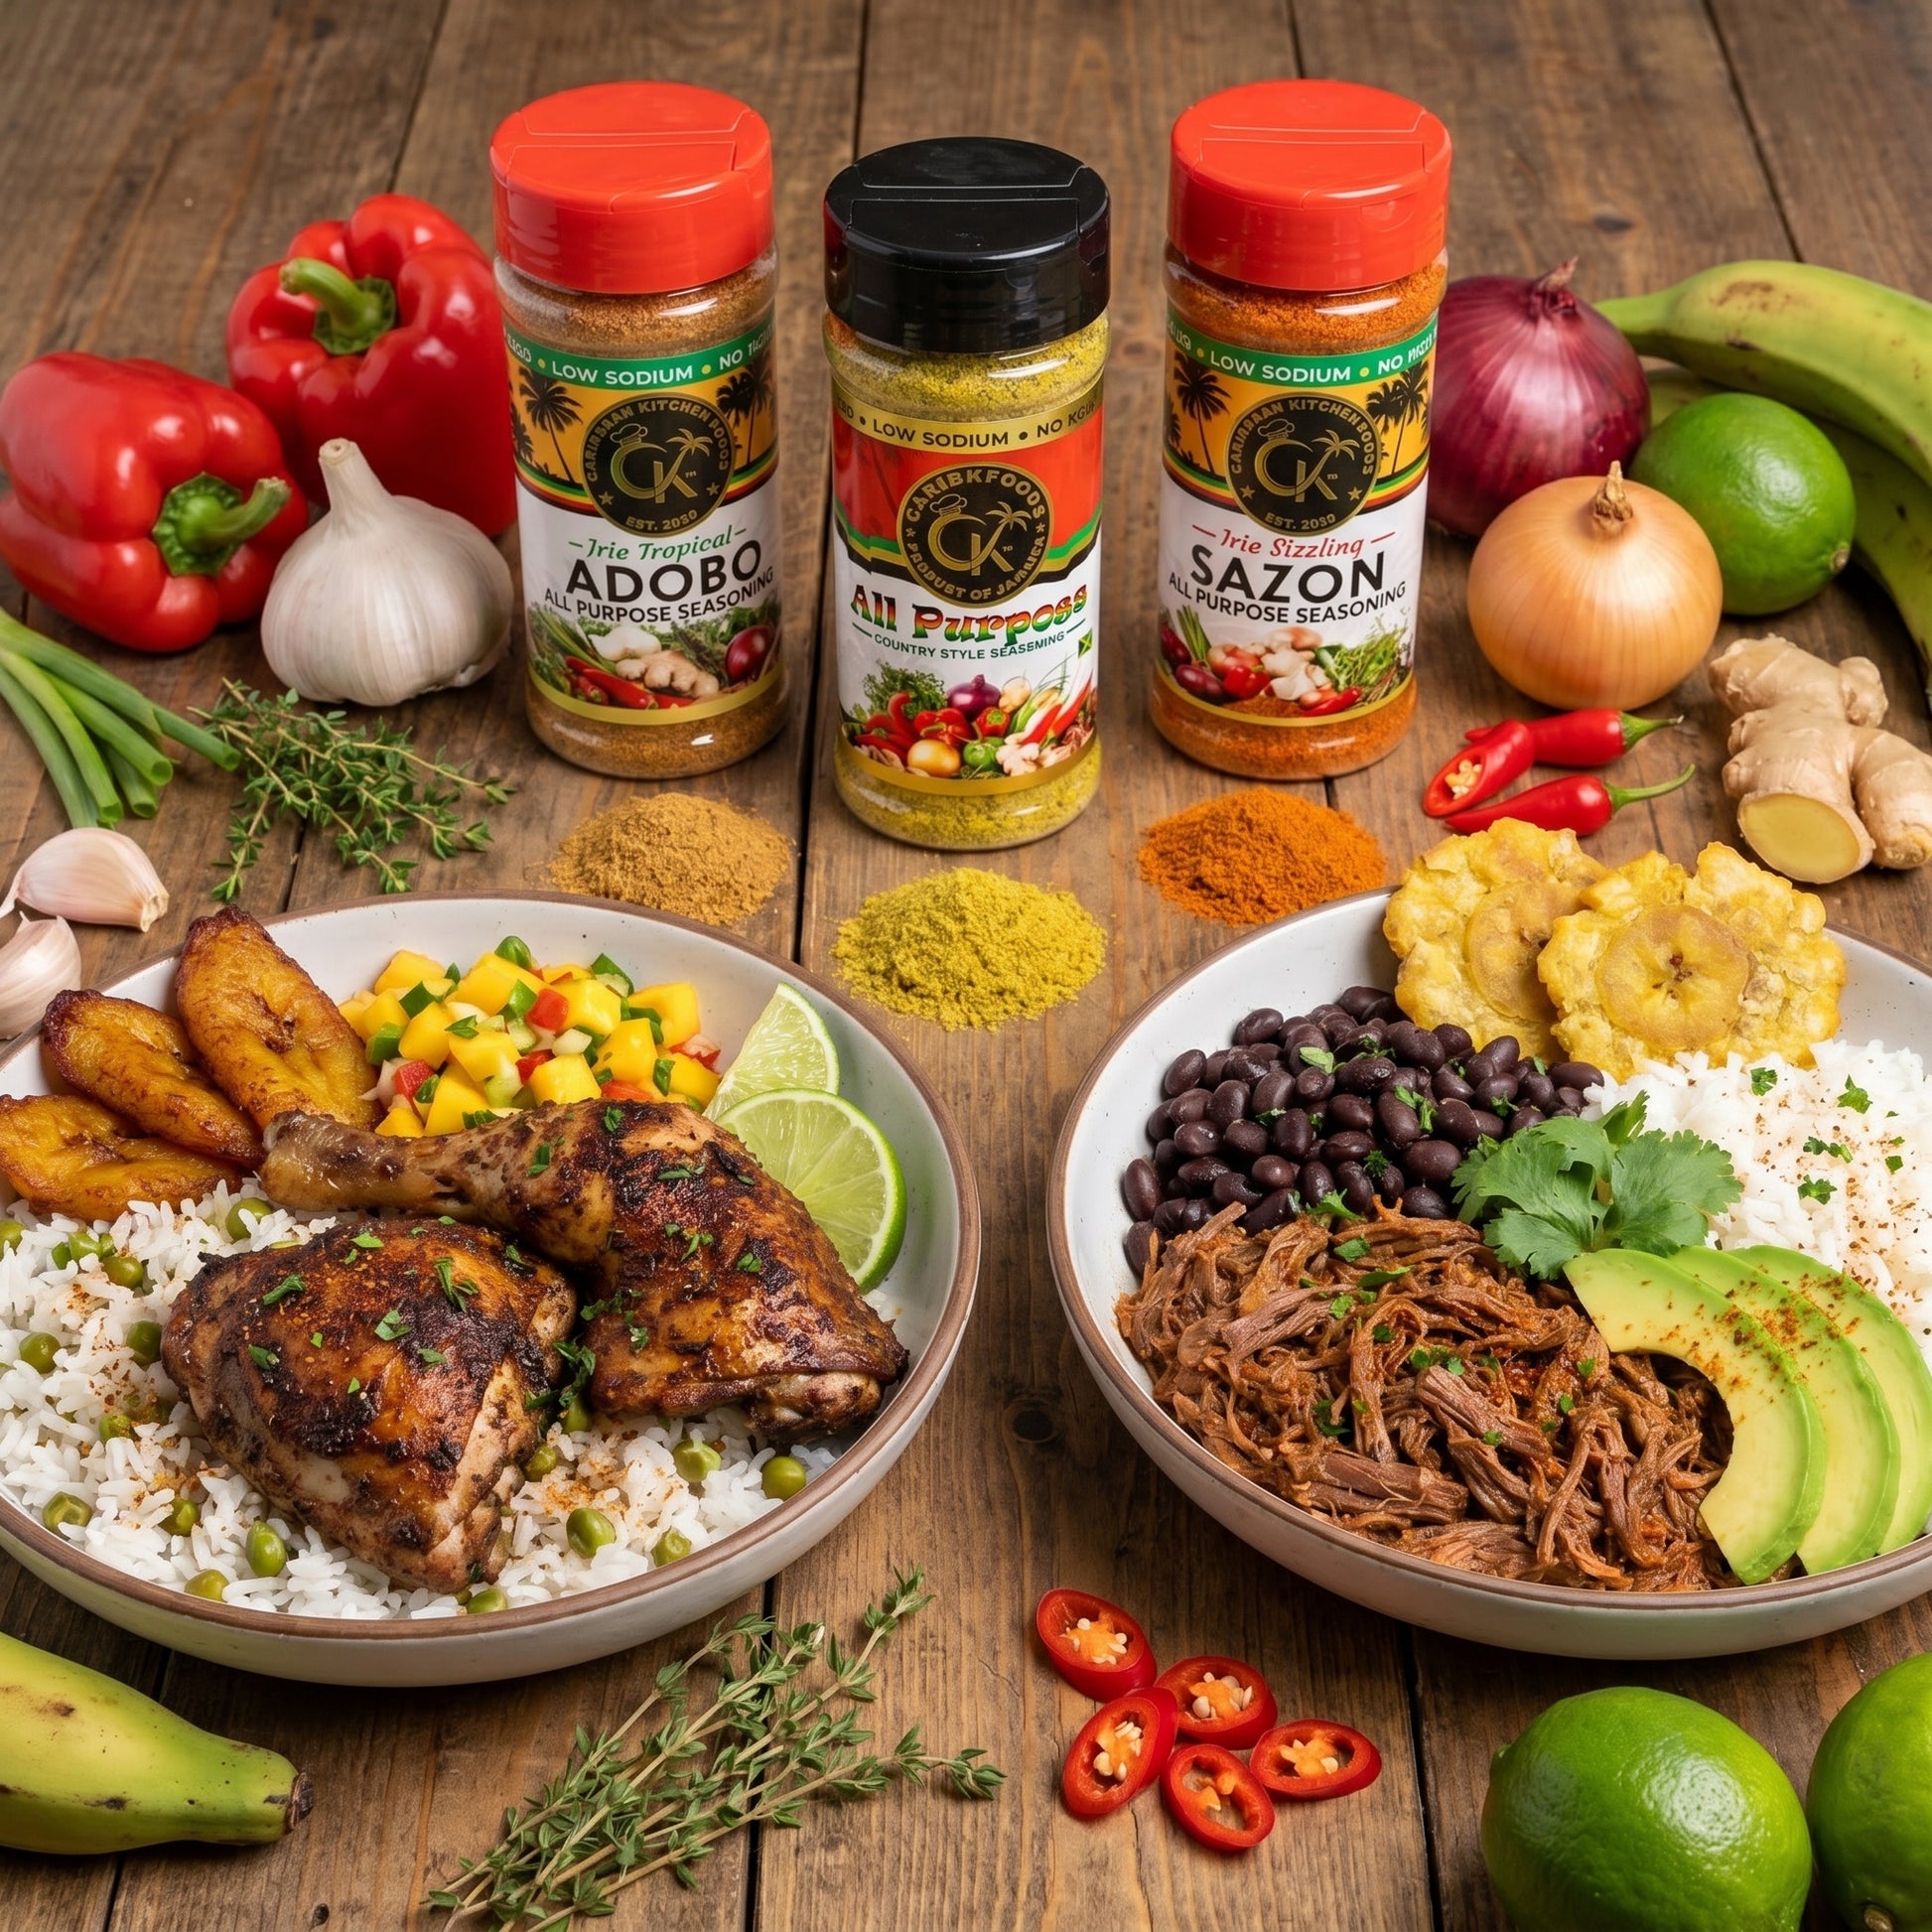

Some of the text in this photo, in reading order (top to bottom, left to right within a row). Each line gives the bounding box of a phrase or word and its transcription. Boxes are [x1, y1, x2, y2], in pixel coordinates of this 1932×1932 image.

[552, 348, 743, 386] LOW SODIUM NO
[1210, 349, 1404, 383] LOW SODIUM NO
[637, 399, 711, 422] KITCHEN
[1289, 399, 1362, 425] KITCHEN
[873, 418, 916, 442] LOW
[922, 431, 1009, 448] SODIUM
[1036, 419, 1063, 438] NO
[638, 524, 732, 563] Tropical
[1270, 537, 1364, 559] Sizzling
[566, 539, 761, 603] ADOBO
[1190, 544, 1384, 604] SAZON
[544, 566, 773, 623] ALL PURPOSE SEASONING
[851, 584, 897, 632] All
[970, 588, 992, 601] OF
[1169, 572, 1406, 623] ALL PURPOSE SEASONING
[874, 632, 935, 657] COUNTRY
[940, 648, 985, 660] STYLE
